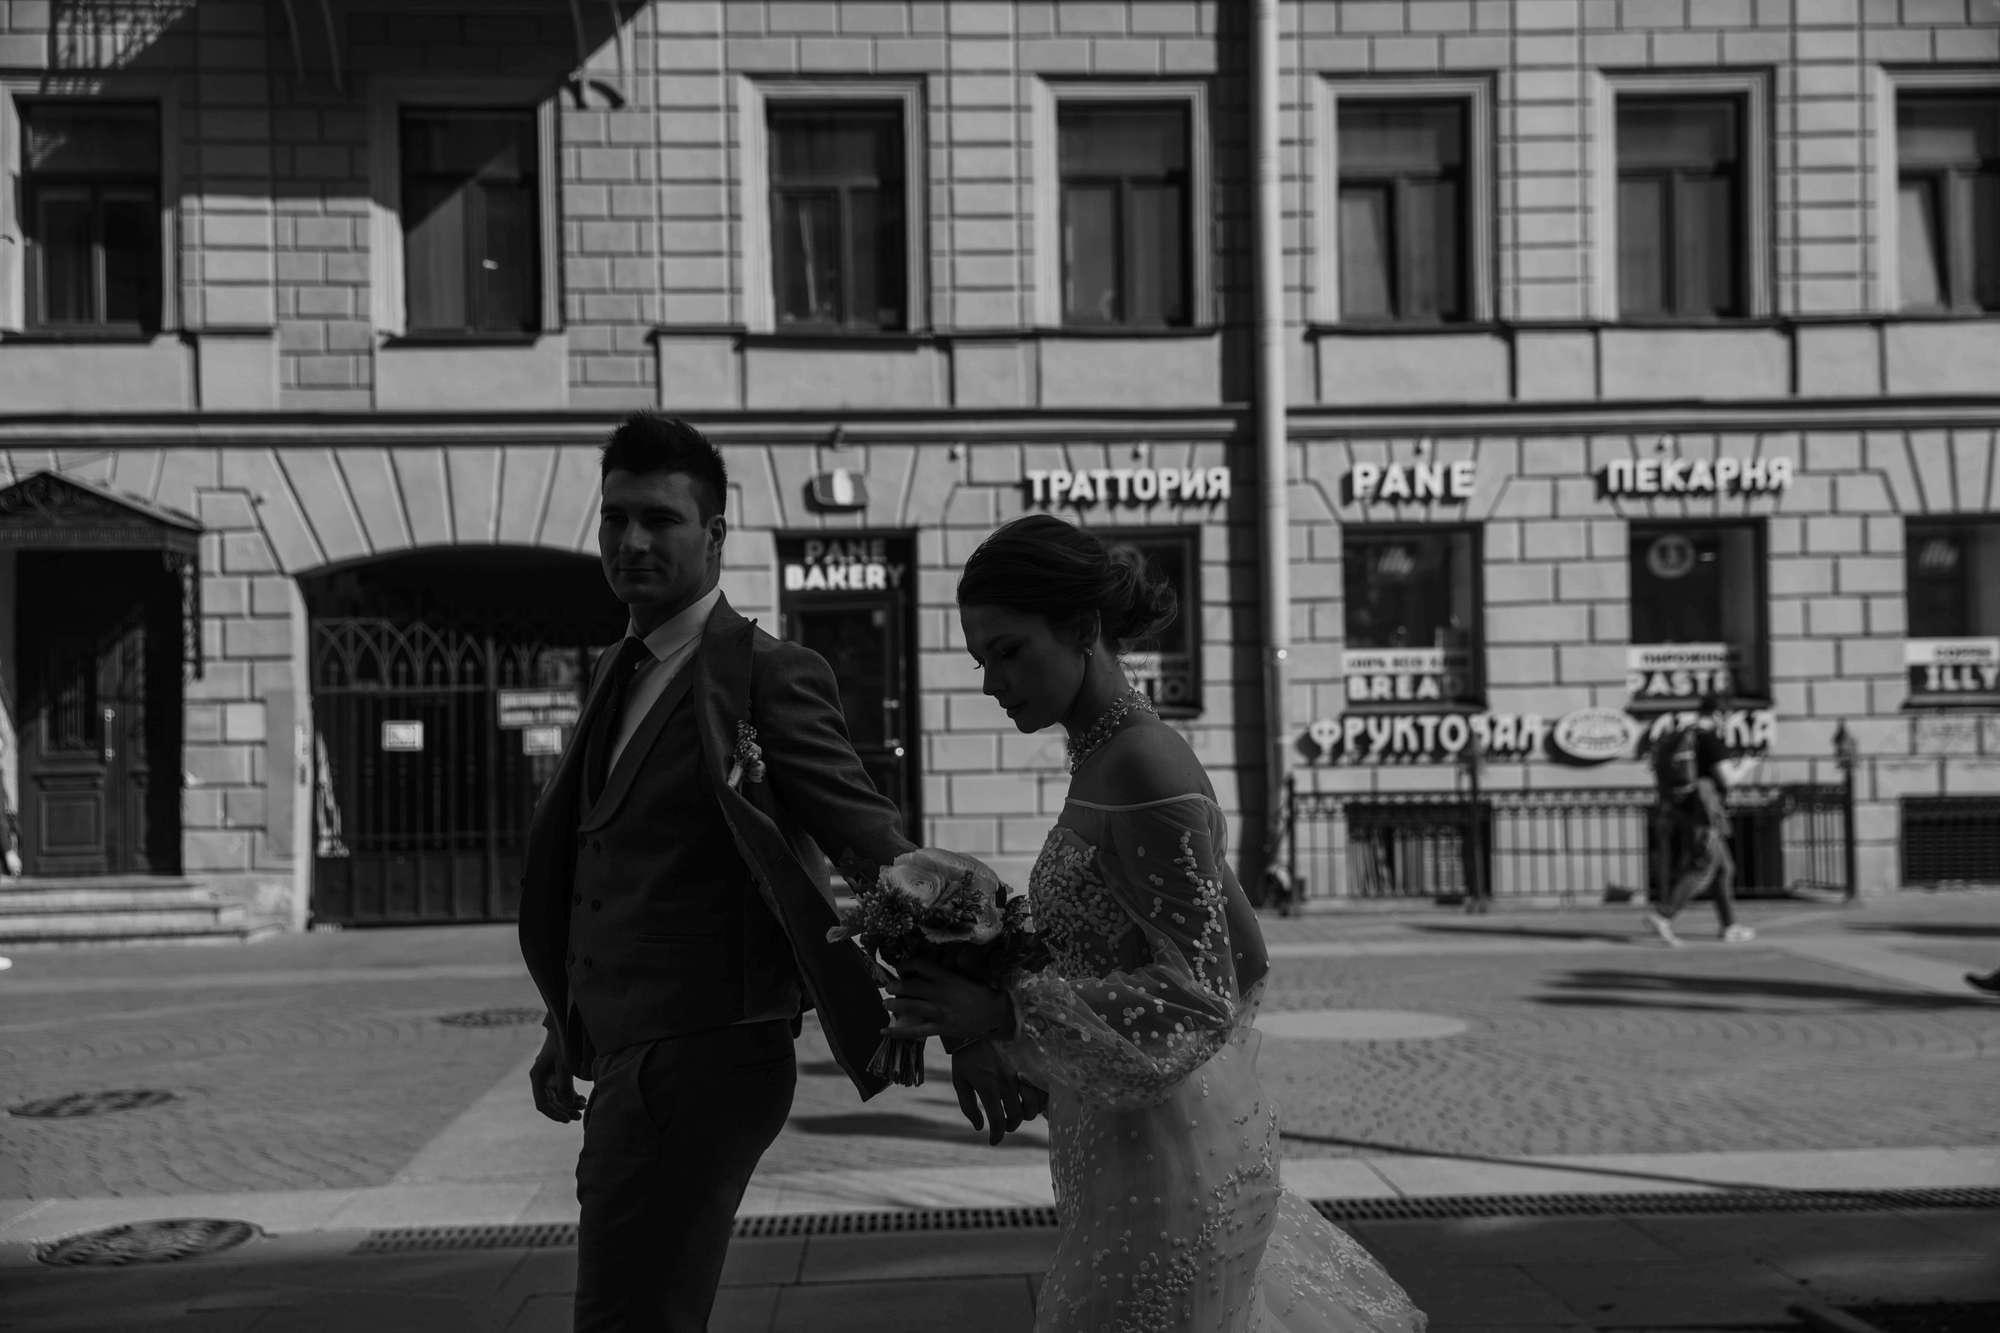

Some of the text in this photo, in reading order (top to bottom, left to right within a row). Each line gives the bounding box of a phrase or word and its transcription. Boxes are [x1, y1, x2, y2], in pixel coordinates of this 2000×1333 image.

[1028, 467, 1230, 502] ТРАТТОРИЯ
[1352, 460, 1476, 499] PANE
[1607, 456, 1793, 493] ПЕКАРНЯ
[804, 539, 888, 564] PANE
[784, 563, 906, 591] BAKERY
[1348, 674, 1464, 700] BREAD
